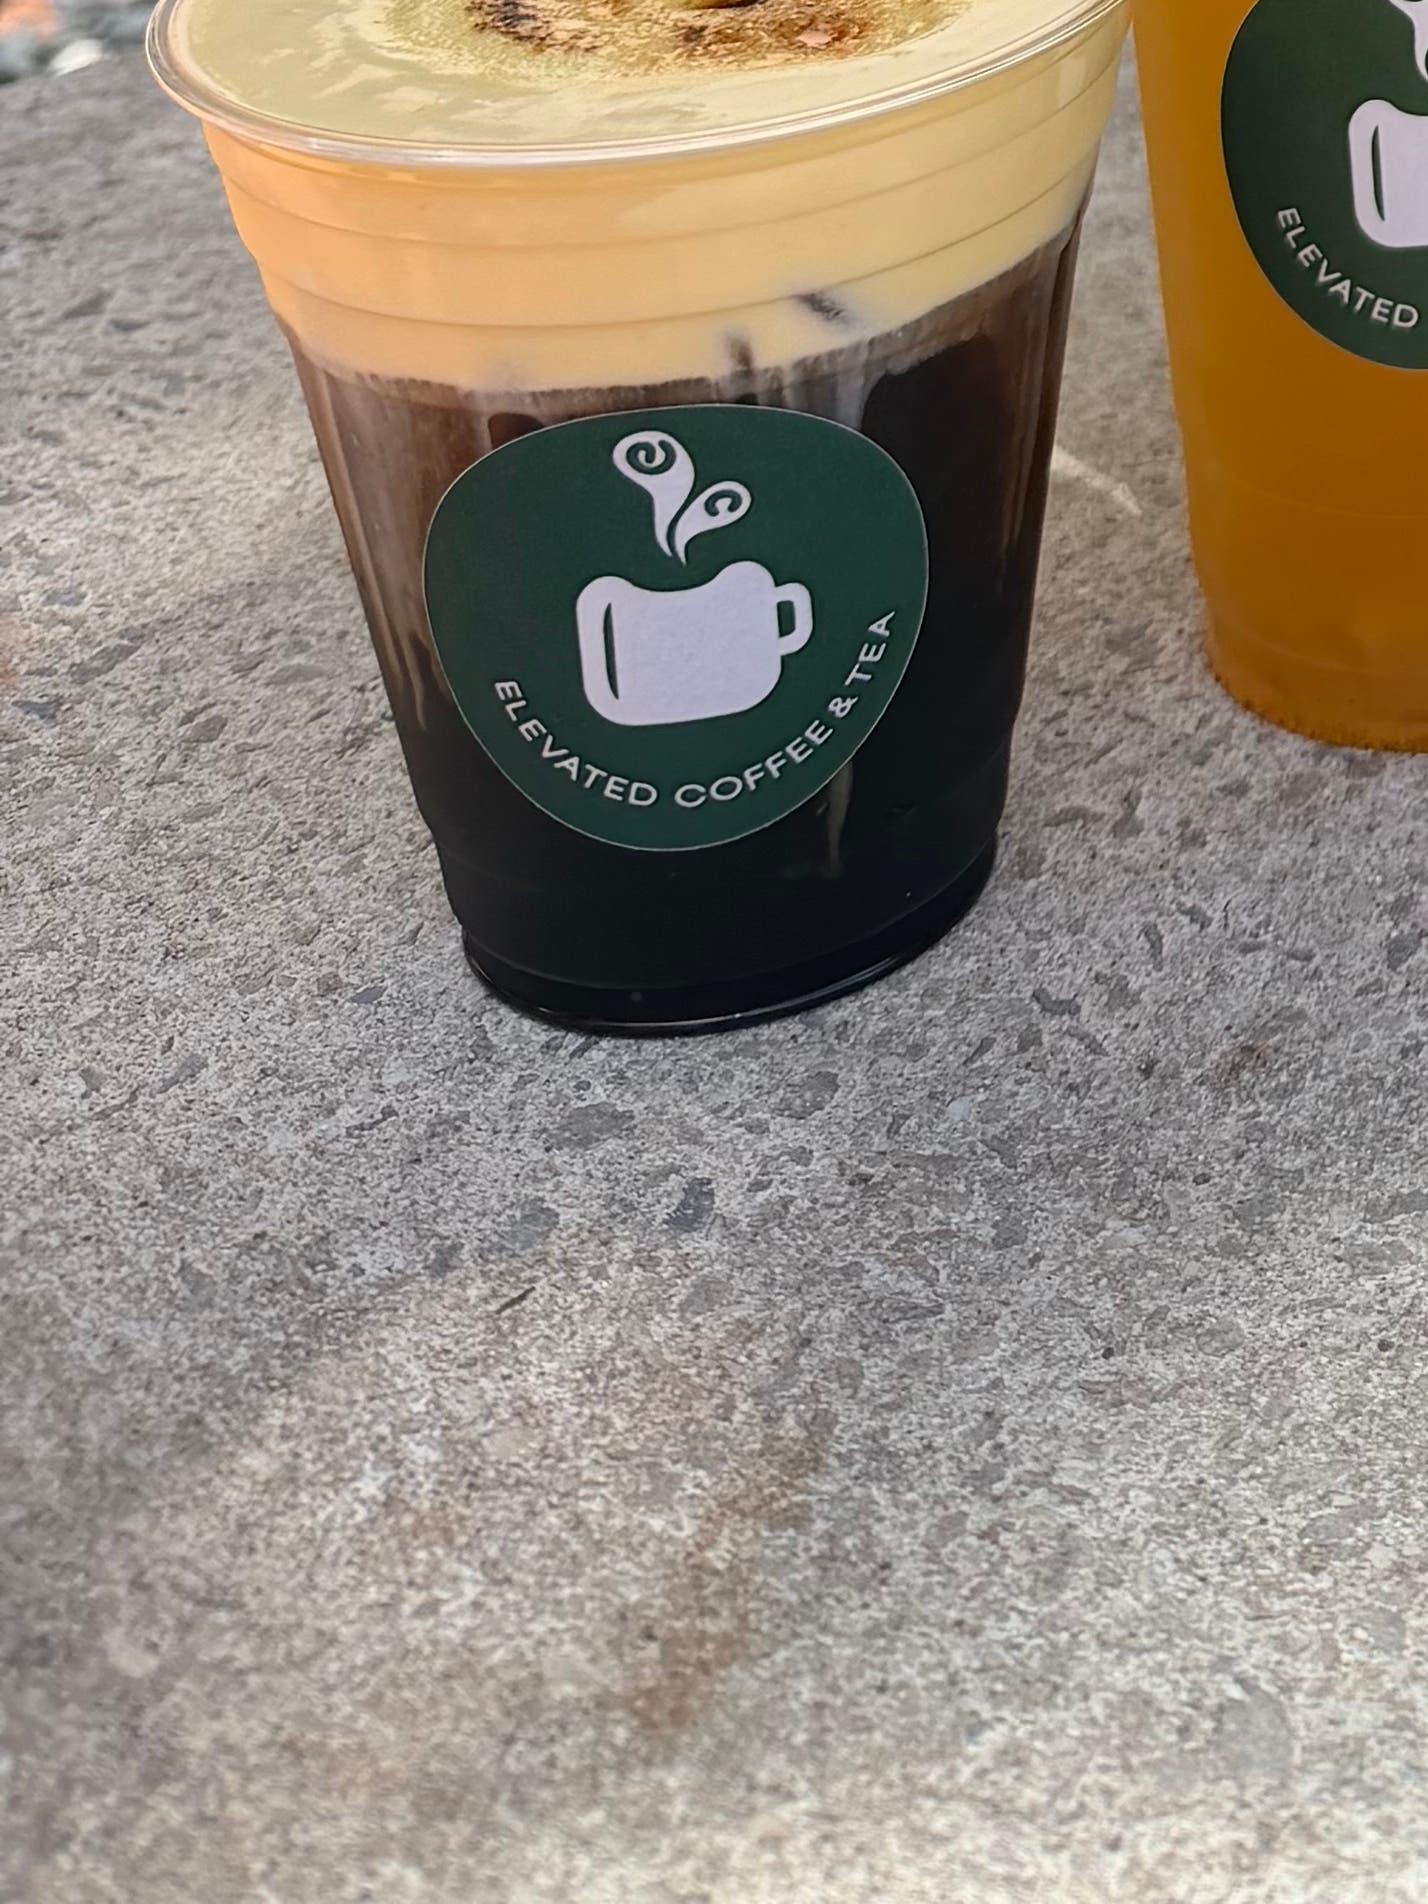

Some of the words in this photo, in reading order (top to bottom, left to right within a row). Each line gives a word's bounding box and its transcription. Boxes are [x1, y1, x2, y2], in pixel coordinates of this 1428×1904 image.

[1277, 206, 1420, 330] ELEVATED
[495, 679, 658, 809] ELEVATED
[674, 720, 833, 809] COFFEE
[828, 694, 858, 719] &
[845, 609, 896, 688] TEA
